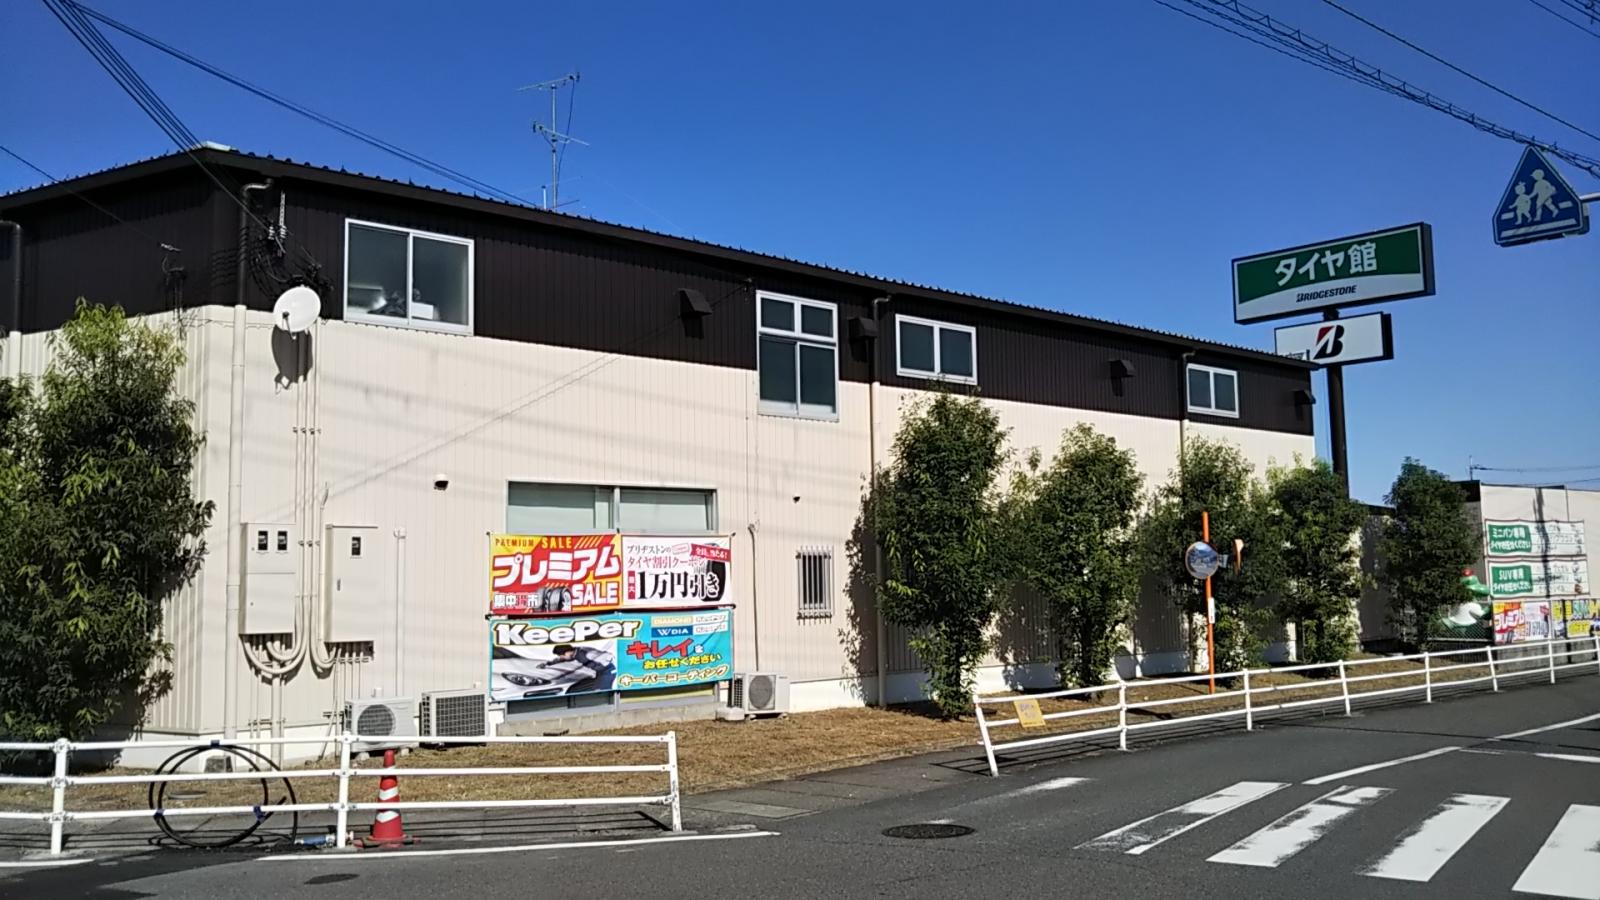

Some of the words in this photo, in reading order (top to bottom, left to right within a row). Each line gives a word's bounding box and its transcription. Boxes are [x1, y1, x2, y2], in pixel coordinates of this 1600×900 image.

[1275, 241, 1377, 286] タイヤ館
[1296, 285, 1357, 303] BRIDGESTONE
[541, 536, 572, 549] SALE
[494, 546, 620, 588] プレミアム
[627, 555, 706, 569] タイヤ割引クーポン
[571, 582, 618, 606] SALE
[637, 570, 719, 599] 1万円引き
[496, 620, 639, 645] KeePer
[644, 654, 722, 669] お任せください
[620, 666, 727, 685] キーパーコーティング
